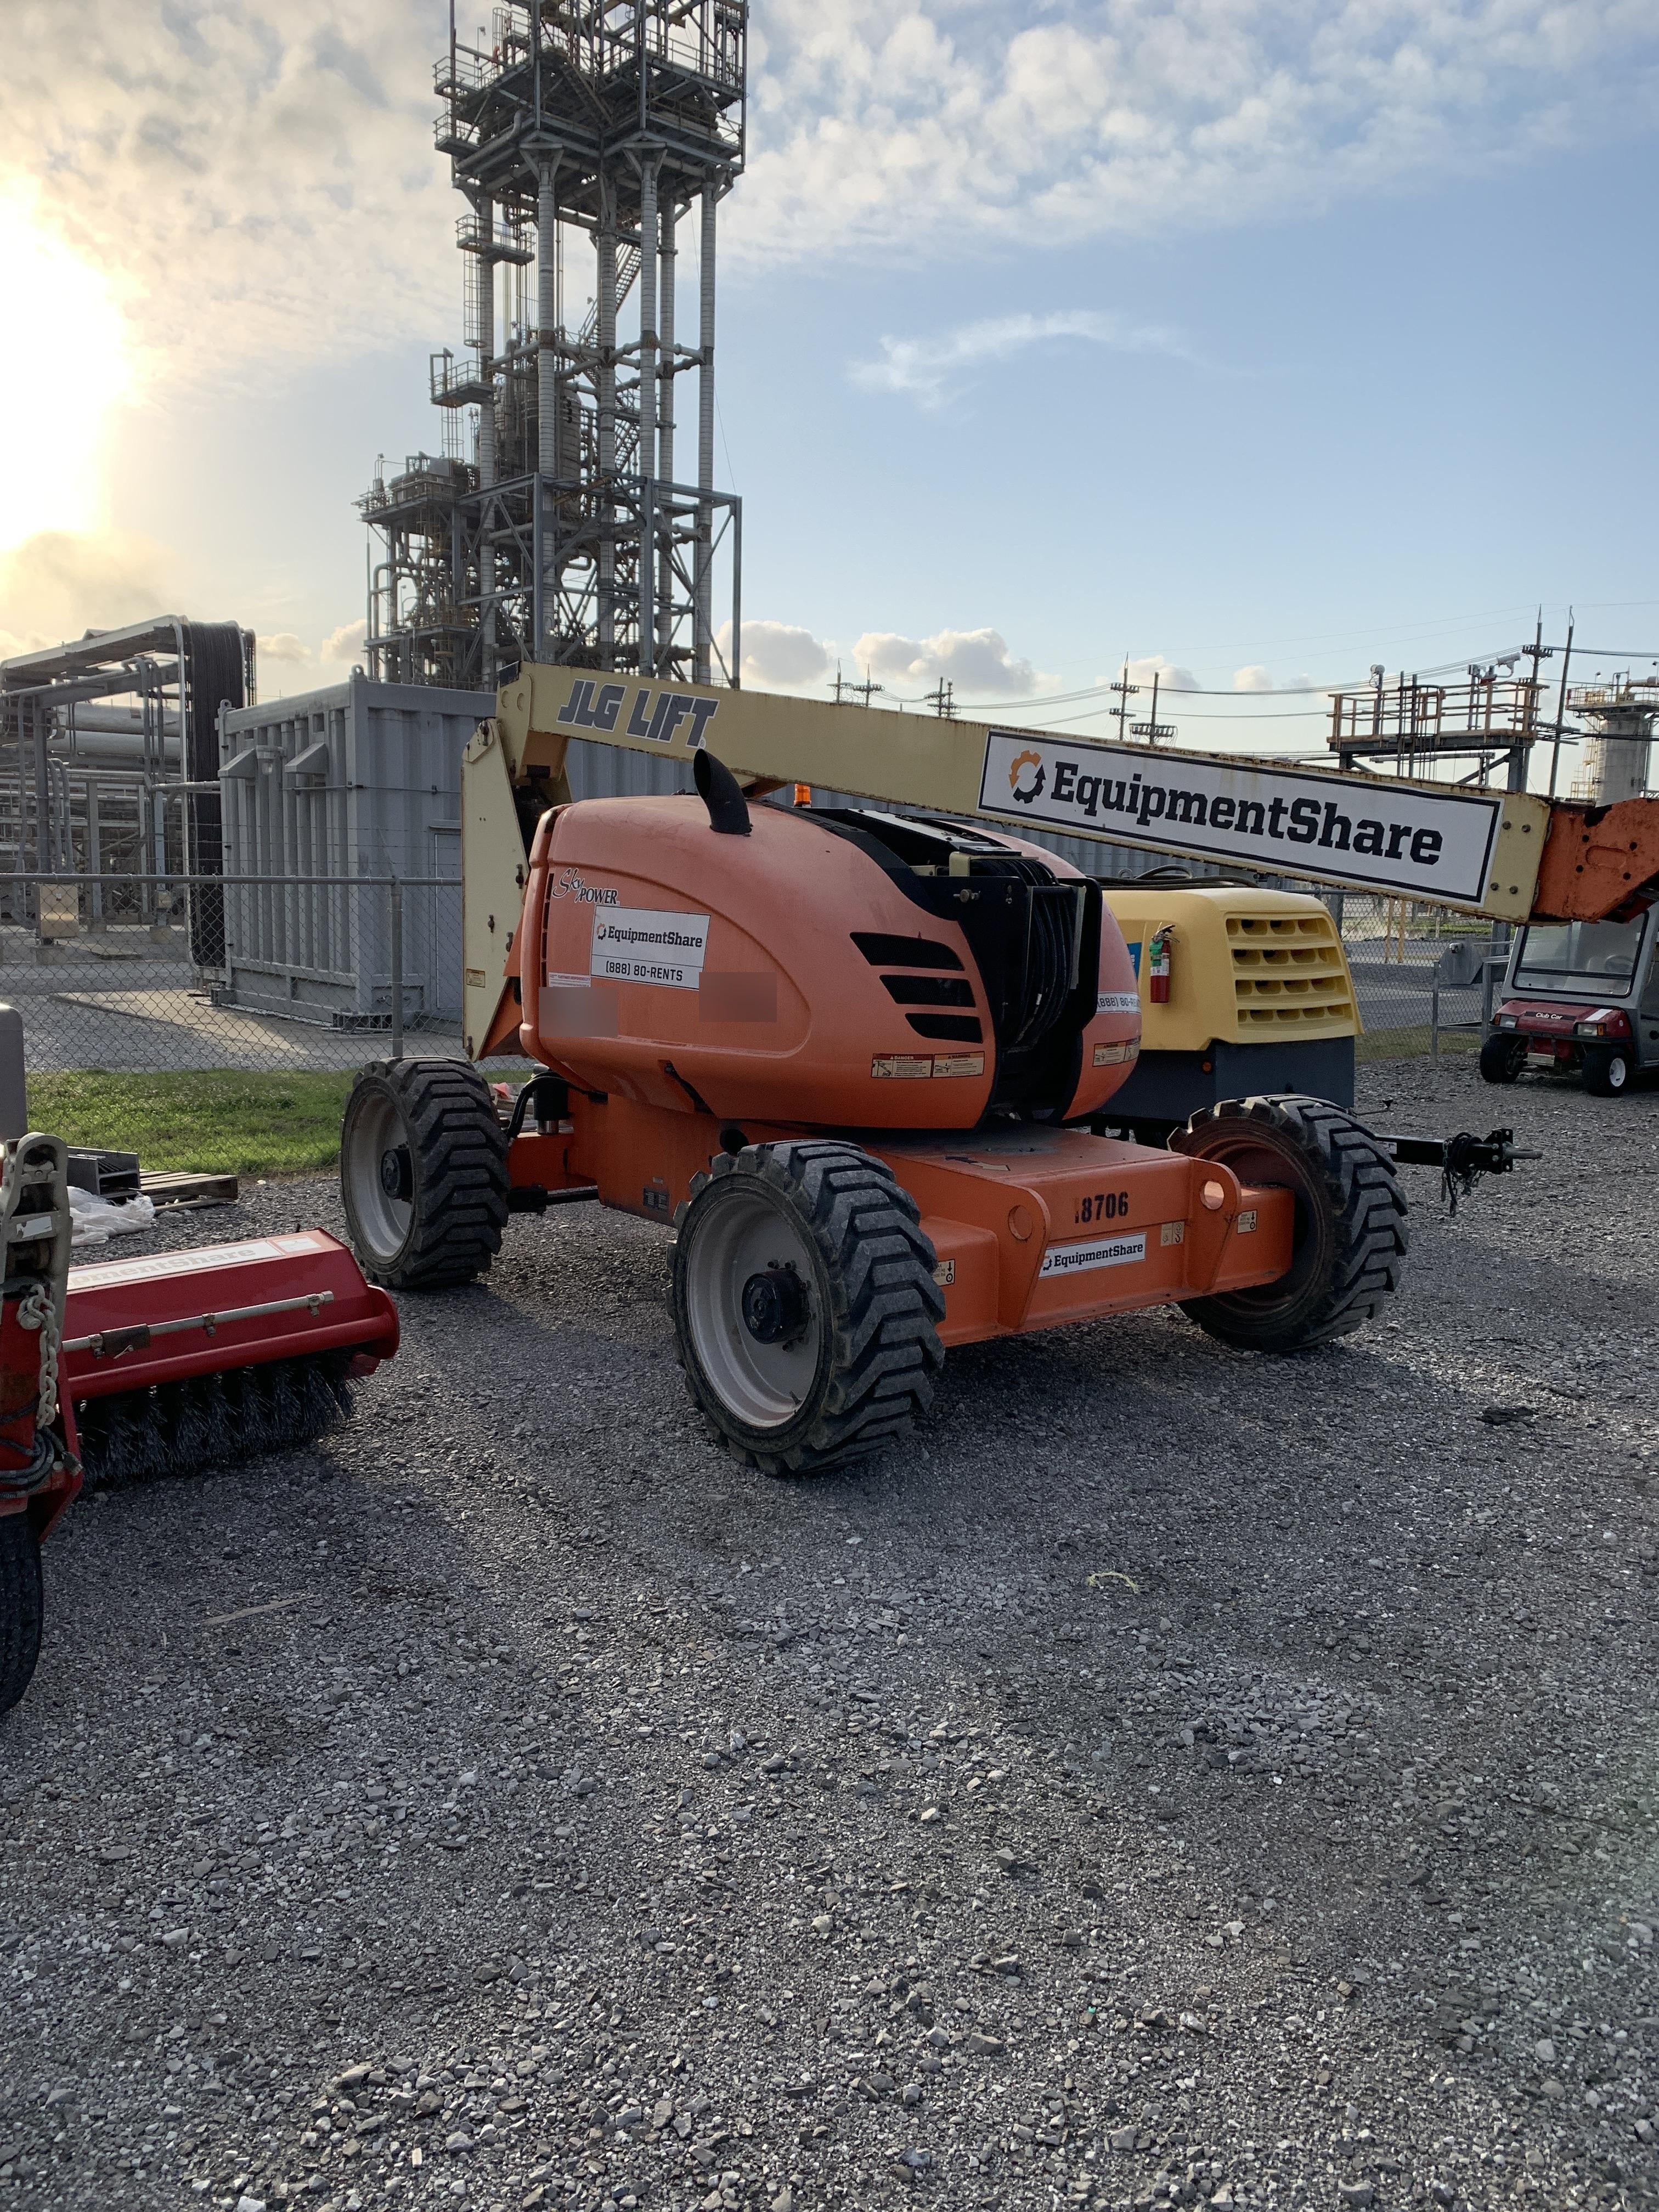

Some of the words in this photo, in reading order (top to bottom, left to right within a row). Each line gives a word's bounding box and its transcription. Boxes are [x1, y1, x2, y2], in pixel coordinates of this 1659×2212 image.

[556, 679, 627, 732] JLG
[625, 688, 720, 749] LIFT
[1051, 761, 1443, 865] EquipmentShare
[608, 926, 703, 947] EquipmentShare
[606, 960, 631, 976] (888)
[634, 964, 683, 981] 80-RENTS
[69, 1248, 256, 1285] pmentShare
[1054, 1243, 1143, 1268] EquipmentShare
